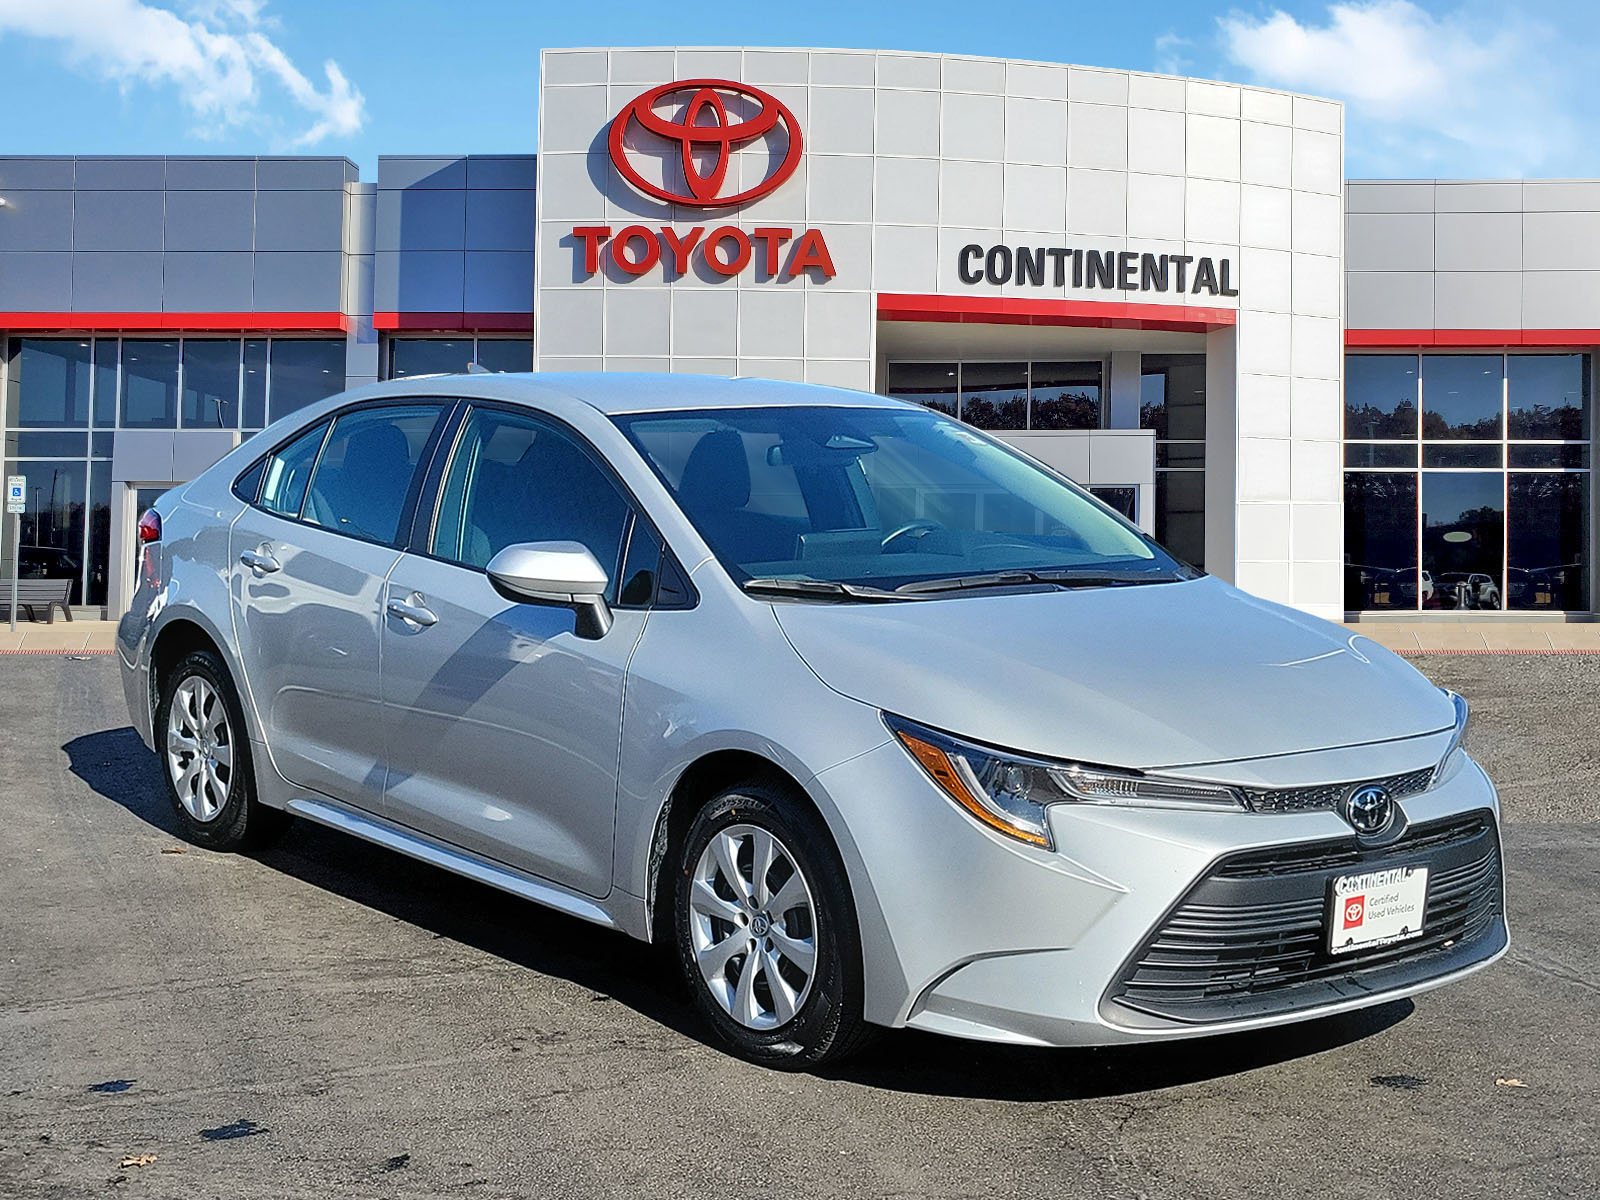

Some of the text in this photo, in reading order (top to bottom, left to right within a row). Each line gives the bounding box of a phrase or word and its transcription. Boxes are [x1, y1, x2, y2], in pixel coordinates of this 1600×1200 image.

[573, 225, 836, 276] TOYOTA
[959, 244, 1239, 296] CONTINENTAL
[1368, 904, 1415, 920] Used Vehicles
[1369, 892, 1399, 907] Certified
